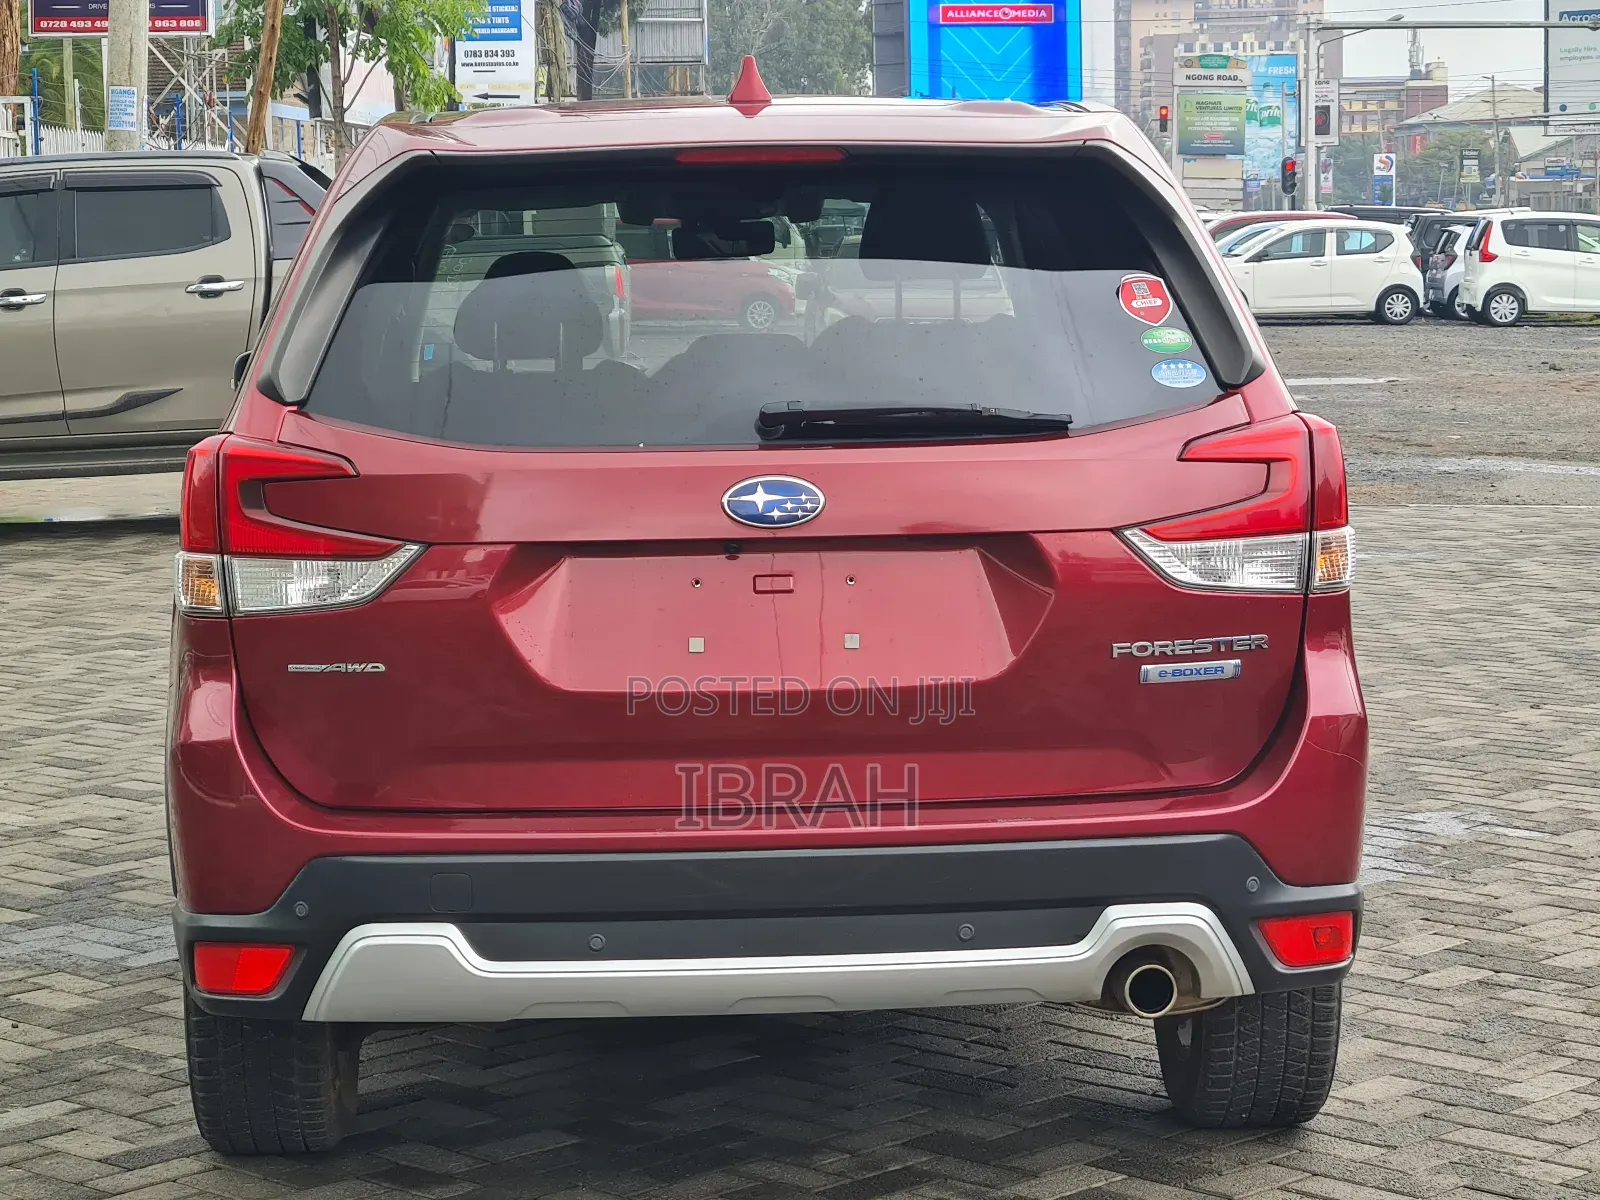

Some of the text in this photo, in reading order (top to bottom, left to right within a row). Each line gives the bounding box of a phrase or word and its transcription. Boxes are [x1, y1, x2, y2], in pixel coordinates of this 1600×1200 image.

[946, 9, 1047, 18] ALLIANCE MEDIA
[40, 20, 67, 28] 0728
[69, 20, 92, 28] 493
[94, 20, 109, 28] 49
[154, 19, 176, 28] 963
[492, 16, 509, 24] TINTS
[464, 49, 515, 58] 0783 834 393
[1267, 65, 1295, 75] FRESH
[1185, 73, 1239, 81] NGONG ROAD
[1135, 298, 1158, 307] CHIEF
[1111, 633, 1269, 659] FORESTER
[322, 662, 386, 673] AWD
[1158, 665, 1225, 678] e-BOXER
